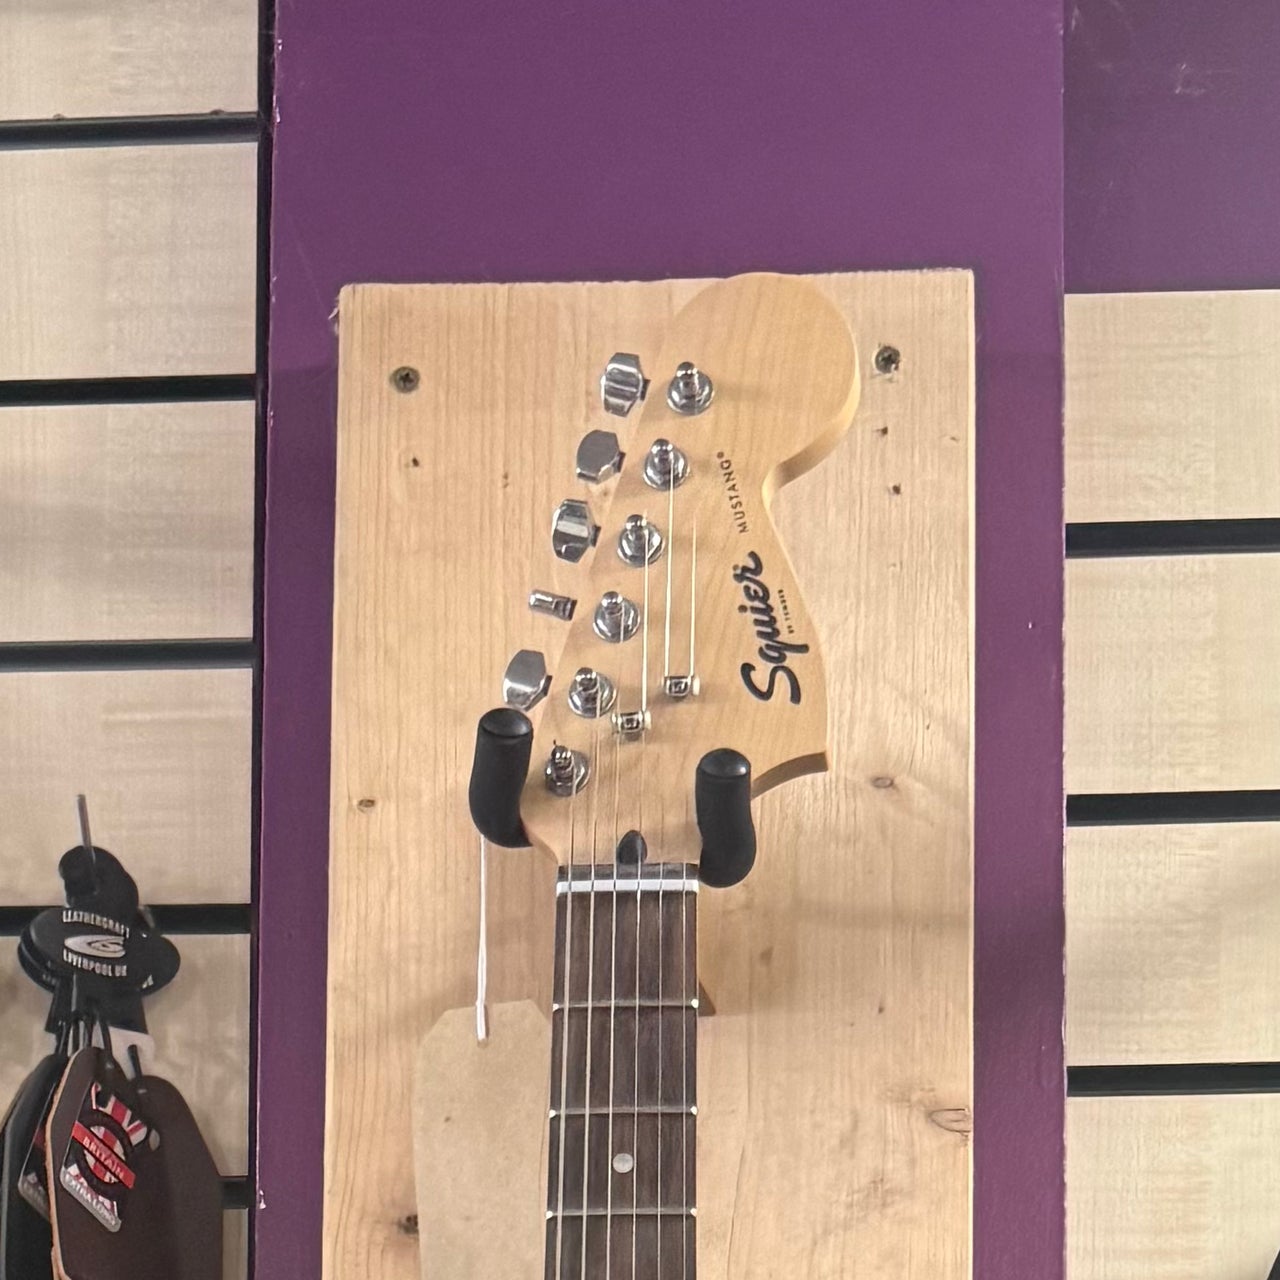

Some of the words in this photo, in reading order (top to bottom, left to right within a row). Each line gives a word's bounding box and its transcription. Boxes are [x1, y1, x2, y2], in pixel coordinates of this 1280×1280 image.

[721, 460, 748, 534] MUSTANG
[733, 550, 809, 705] Squier
[81, 1136, 125, 1180] BRITAIN
